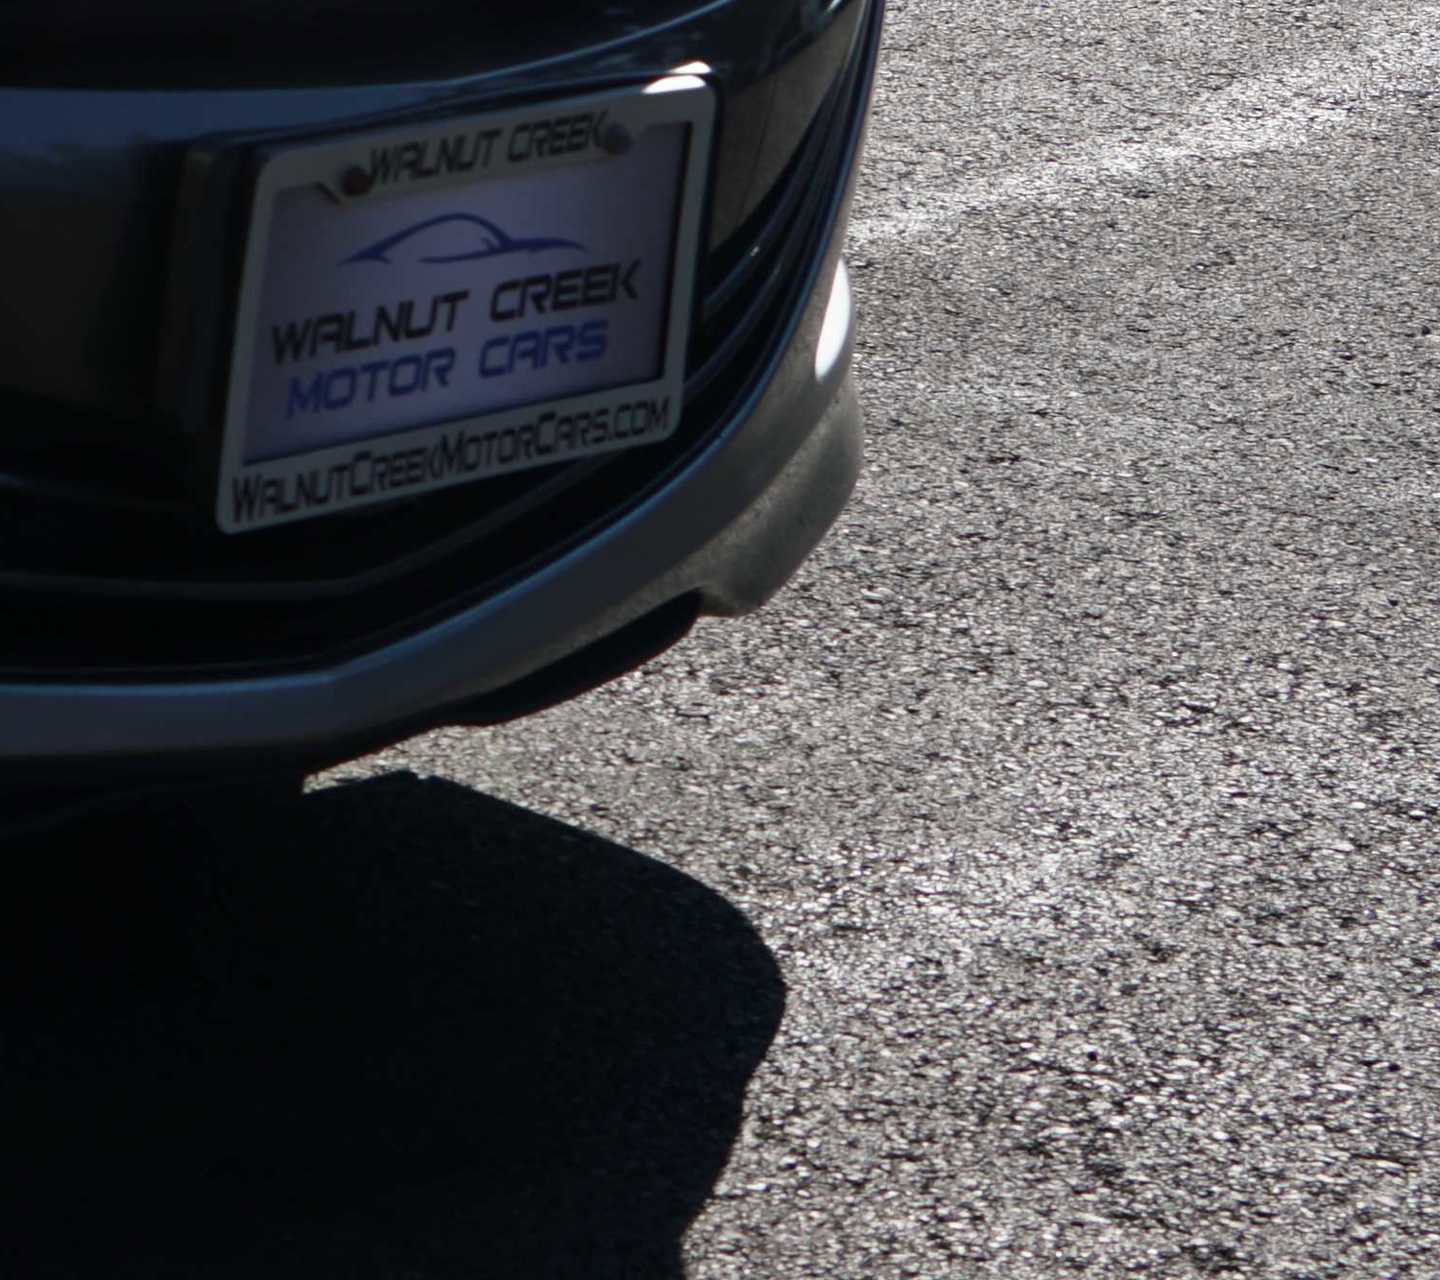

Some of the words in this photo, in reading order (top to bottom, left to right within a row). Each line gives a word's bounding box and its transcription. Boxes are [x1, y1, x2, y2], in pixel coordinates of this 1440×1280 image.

[367, 127, 502, 185] WALNUT
[507, 108, 610, 163] CREEK
[272, 289, 470, 365] WALNUT
[489, 258, 642, 323] CREEK
[284, 347, 456, 419] MOTOR
[477, 319, 609, 379] CARS
